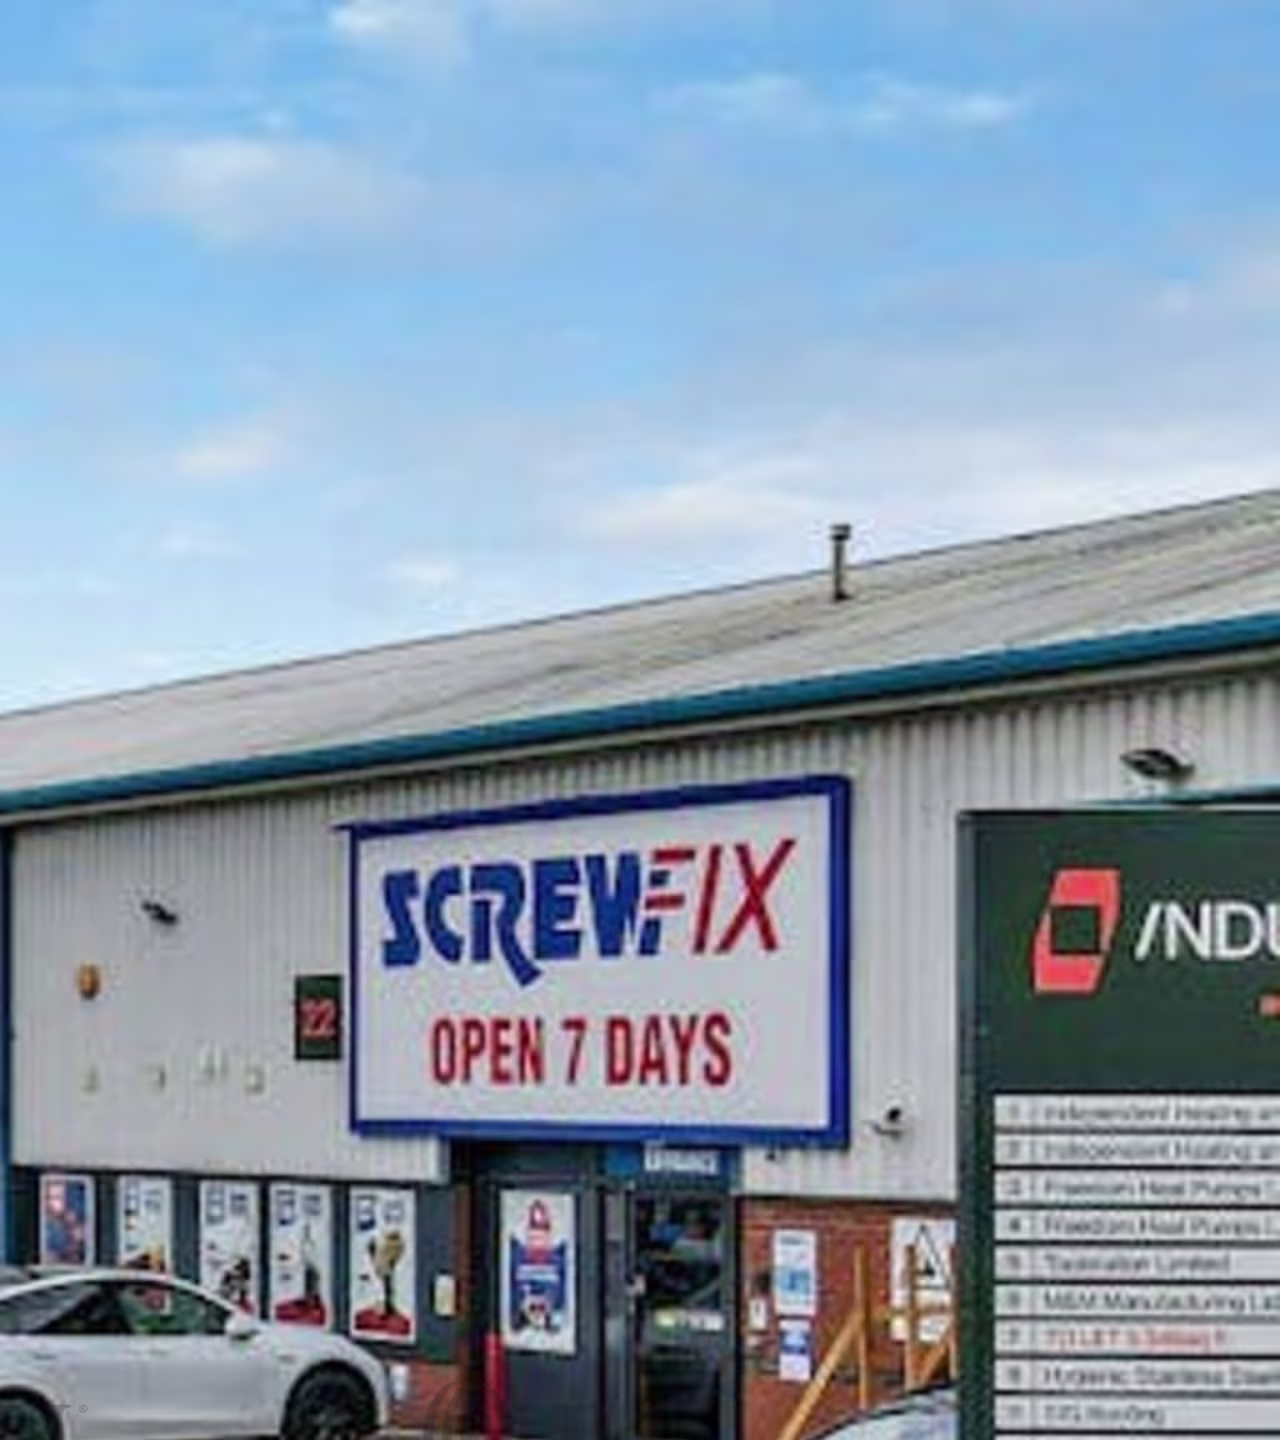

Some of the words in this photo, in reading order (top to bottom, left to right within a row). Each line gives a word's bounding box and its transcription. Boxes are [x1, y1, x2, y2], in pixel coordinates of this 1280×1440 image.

[382, 839, 796, 987] SCREWFIX
[431, 1018, 543, 1085] OPEN
[563, 1016, 588, 1085] 7
[606, 1013, 733, 1087] DAYS
